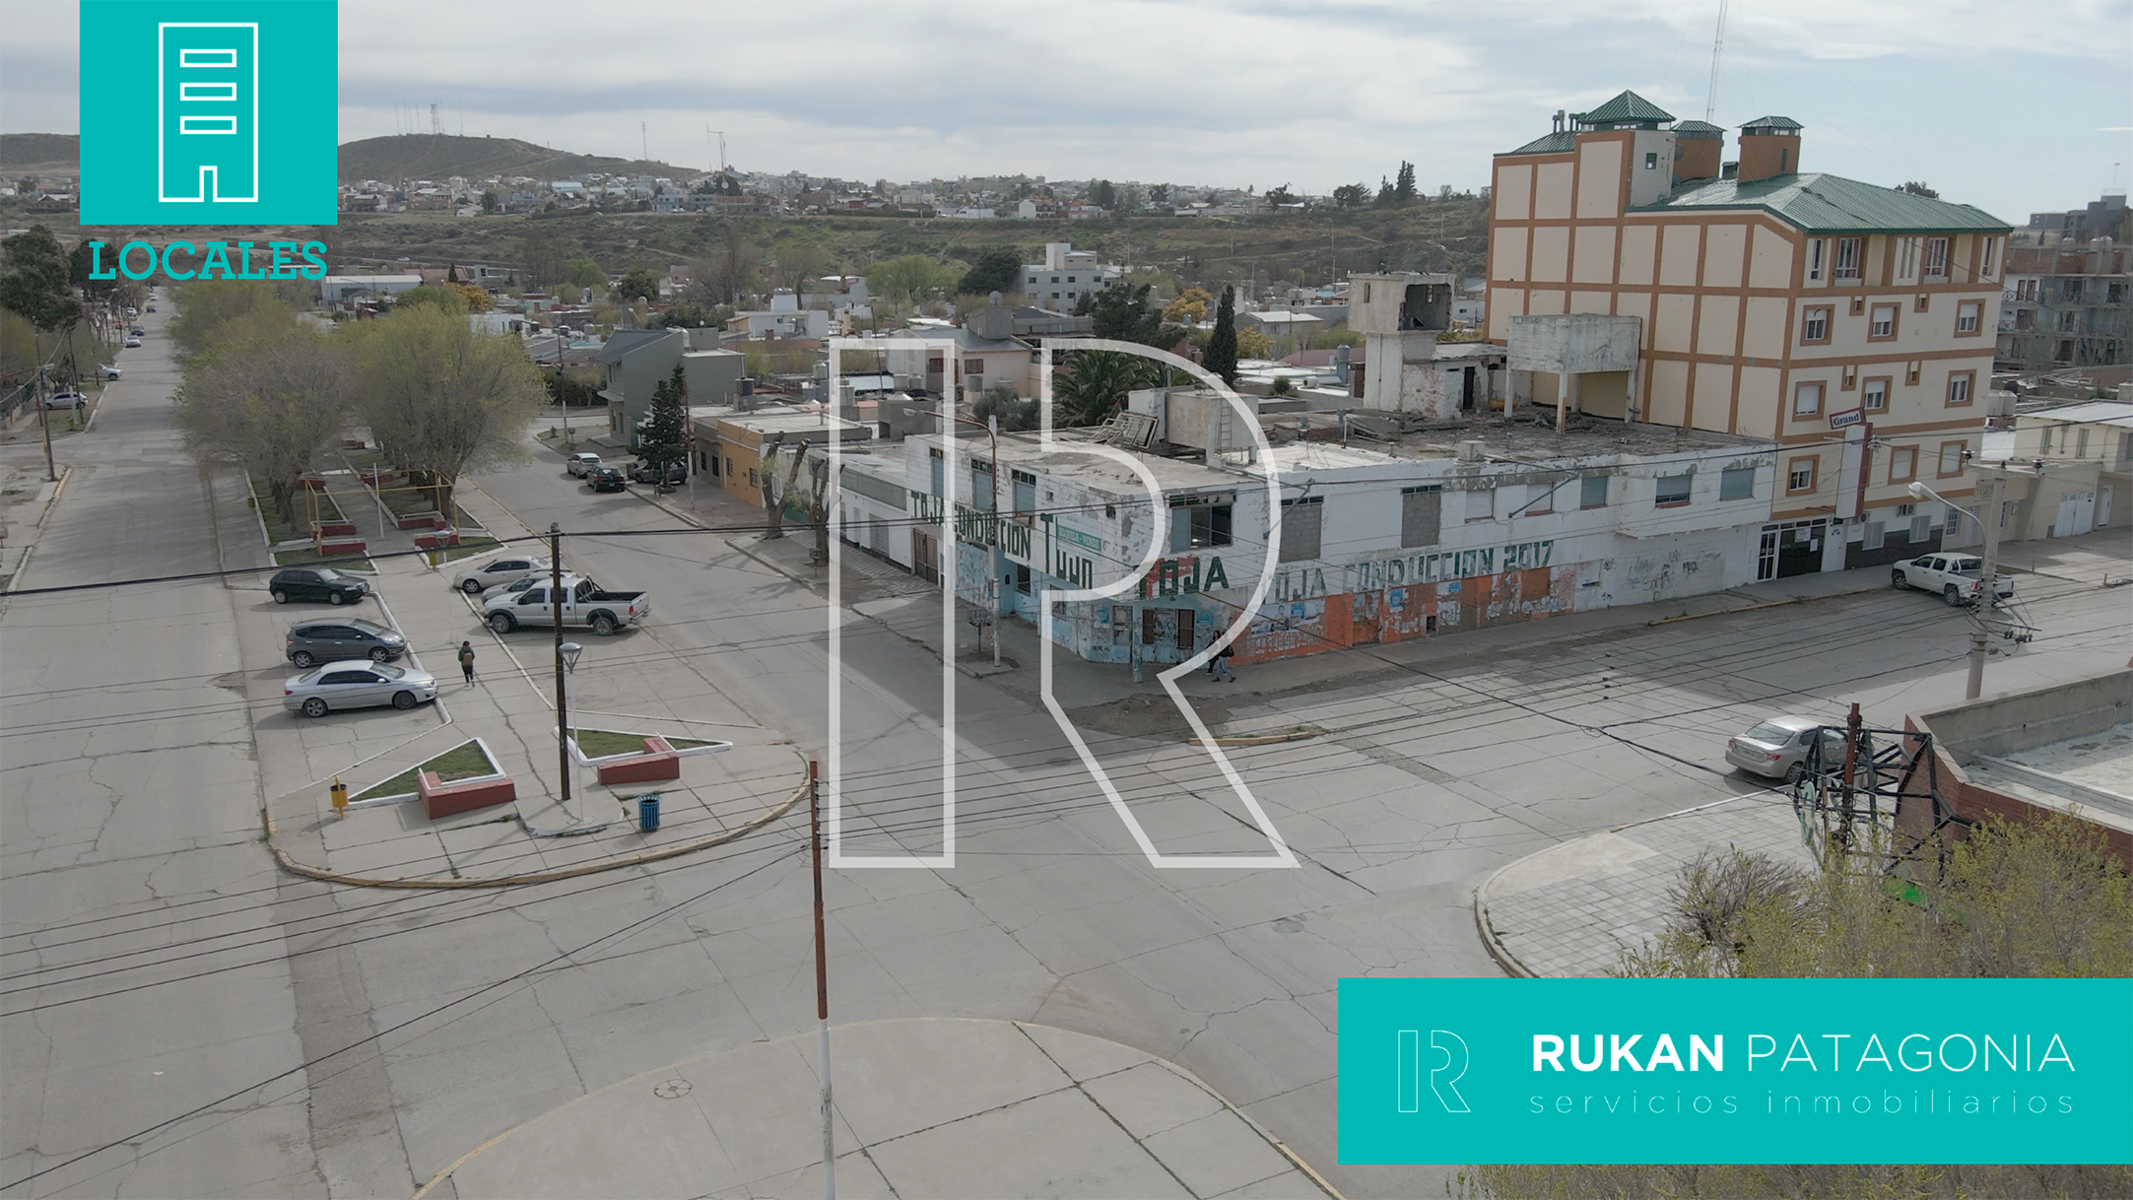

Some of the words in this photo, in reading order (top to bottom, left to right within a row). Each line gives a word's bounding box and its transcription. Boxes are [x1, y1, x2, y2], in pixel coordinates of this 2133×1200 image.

[1833, 413, 1860, 426] Grand
[951, 501, 1031, 561] CONDUCION
[1059, 527, 1080, 543] ALQUILA
[1083, 535, 1100, 549] VENDE
[1503, 540, 1555, 574] 2017
[1133, 556, 1230, 600] TOJA
